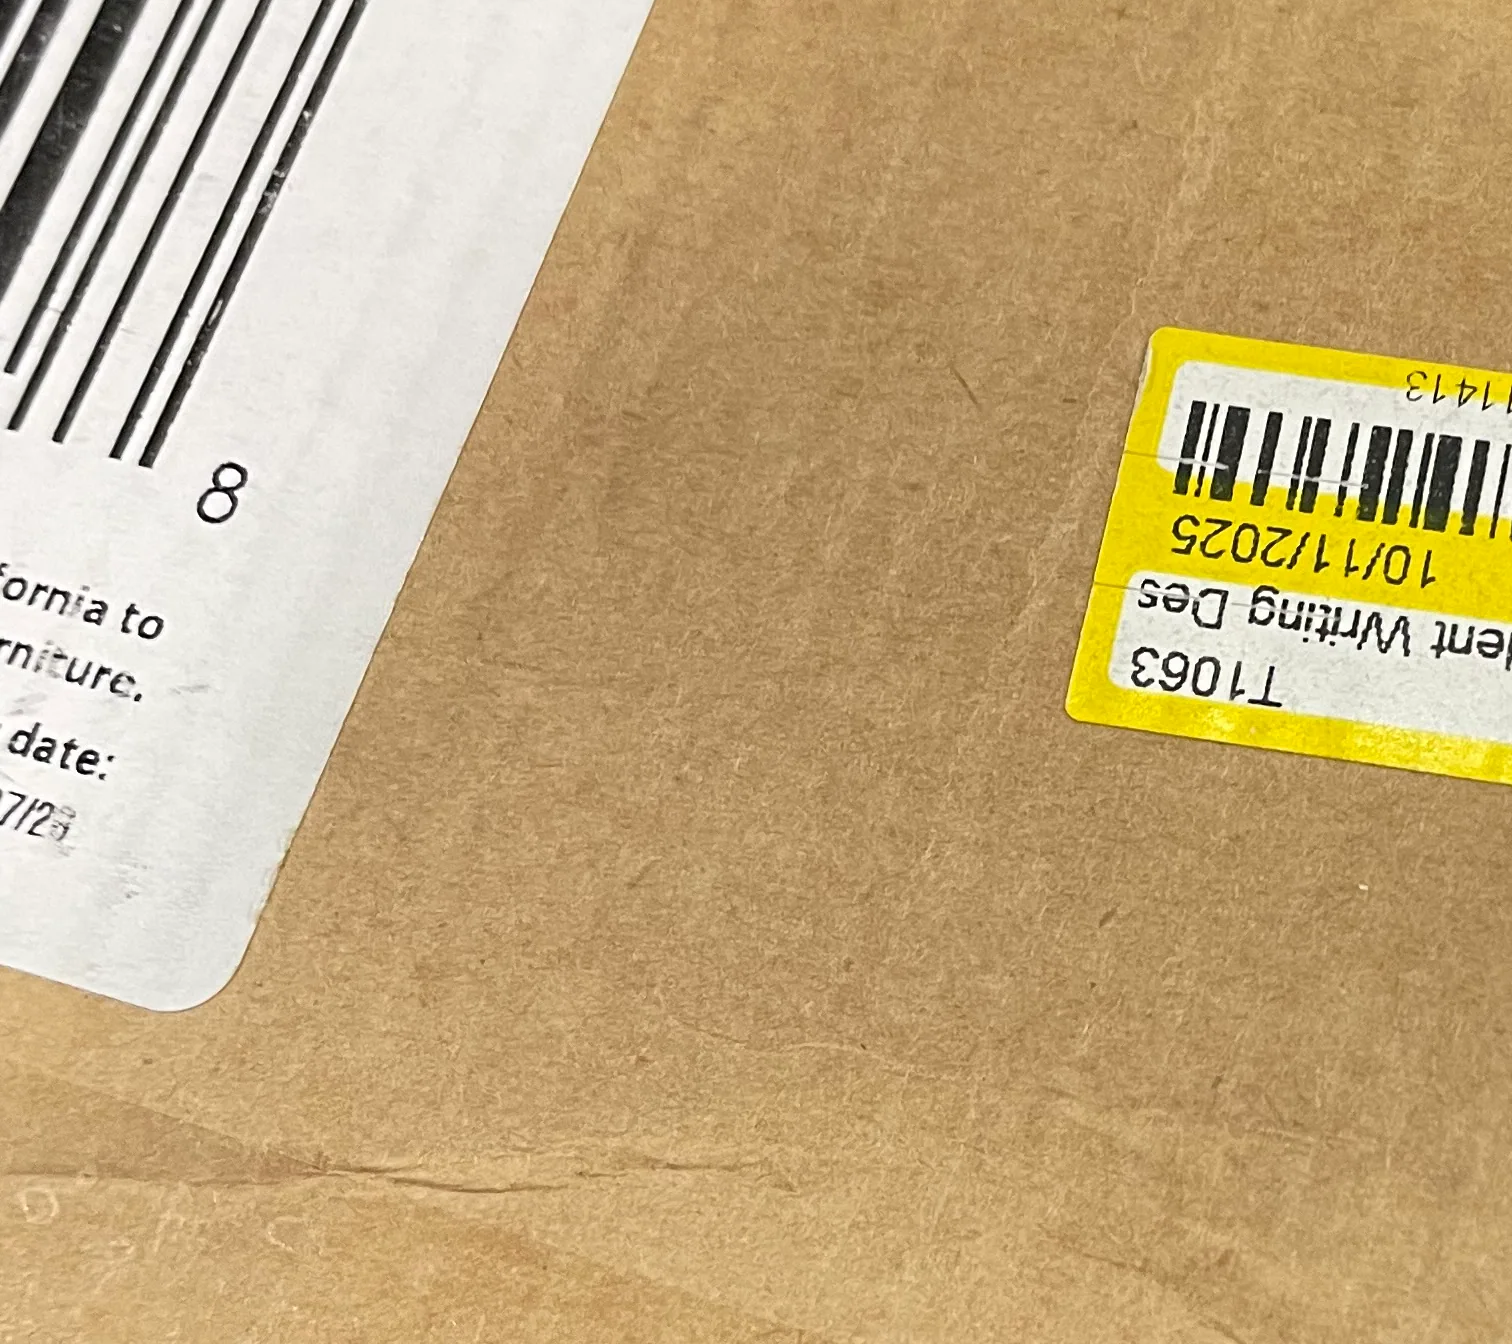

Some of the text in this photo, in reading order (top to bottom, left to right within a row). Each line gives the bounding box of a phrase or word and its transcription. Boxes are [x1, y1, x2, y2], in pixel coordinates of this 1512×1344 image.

[196, 461, 249, 524] 8
[1170, 514, 1437, 589] 10/11/2025
[120, 602, 165, 640] to
[1136, 578, 1230, 630] Des
[1248, 585, 1412, 658] Writing
[1129, 646, 1283, 708] T1063
[7, 721, 116, 781] date:
